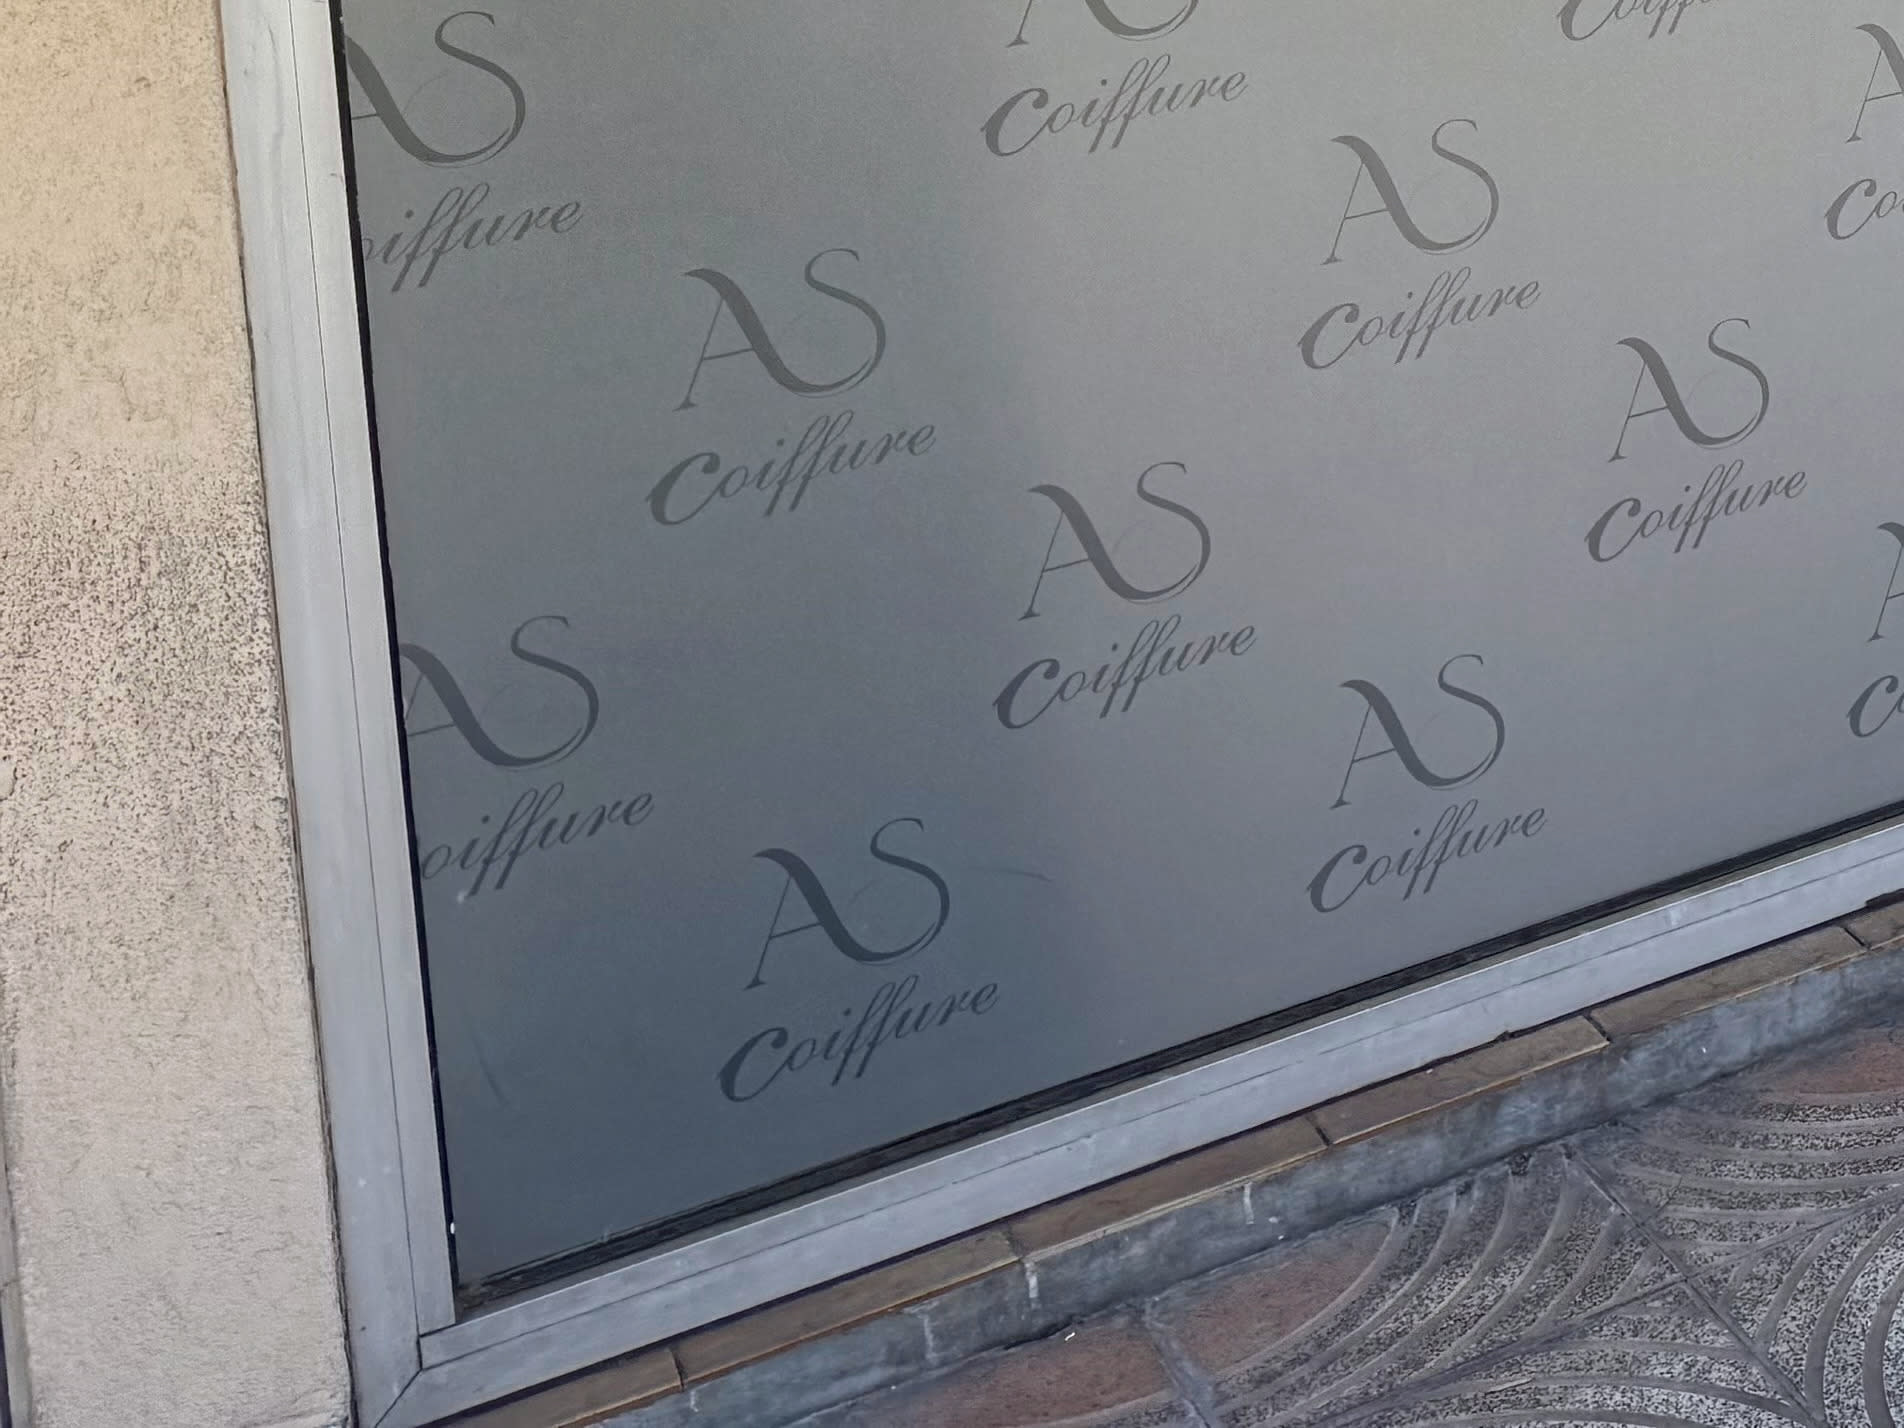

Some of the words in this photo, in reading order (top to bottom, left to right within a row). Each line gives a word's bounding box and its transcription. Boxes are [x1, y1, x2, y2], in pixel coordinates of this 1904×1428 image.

[980, 54, 1248, 157] Coiffure
[362, 181, 584, 292] iffure
[1322, 118, 1499, 265] AS
[675, 248, 886, 411] AS
[1297, 267, 1541, 370] Coiffure
[1607, 318, 1770, 463] AS
[645, 410, 936, 526] Coiffure
[1584, 460, 1807, 563] Coiffure
[1018, 461, 1211, 621] AS
[992, 614, 1256, 730] Coiffure
[1330, 654, 1505, 810] AS
[421, 781, 653, 899] oiffure
[1306, 800, 1547, 913] Coiffure
[744, 817, 950, 990] AS
[718, 975, 998, 1103] Coiffure
